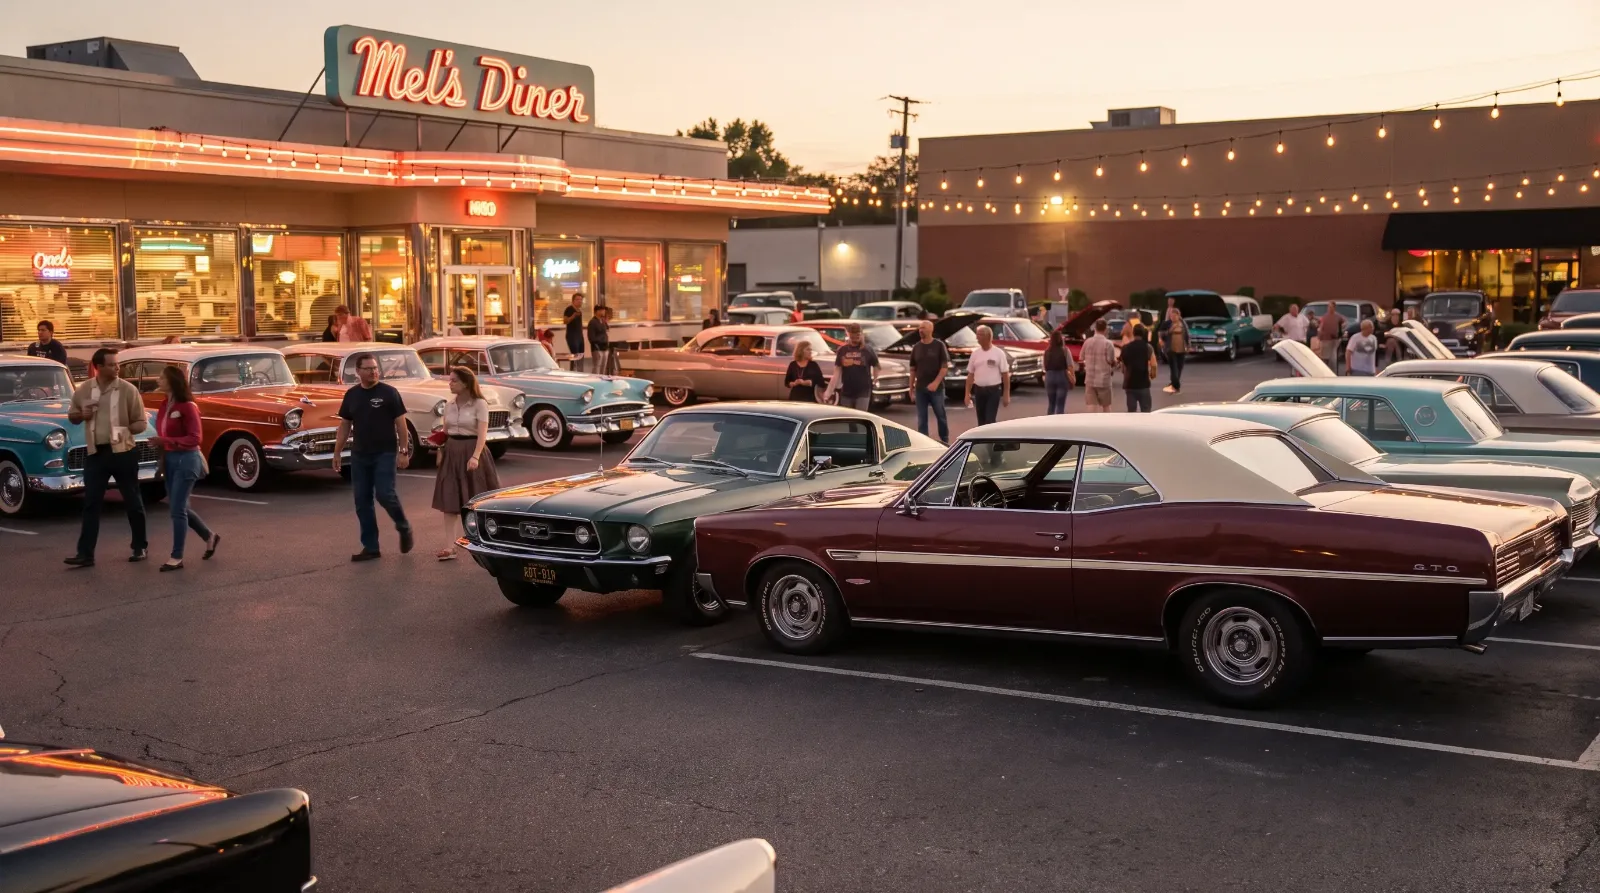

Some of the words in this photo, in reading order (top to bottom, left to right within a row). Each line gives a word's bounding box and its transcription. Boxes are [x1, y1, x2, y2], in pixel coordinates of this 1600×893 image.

[352, 36, 467, 107] Mel's
[478, 55, 589, 122] Diner
[1413, 563, 1460, 573] GTO
